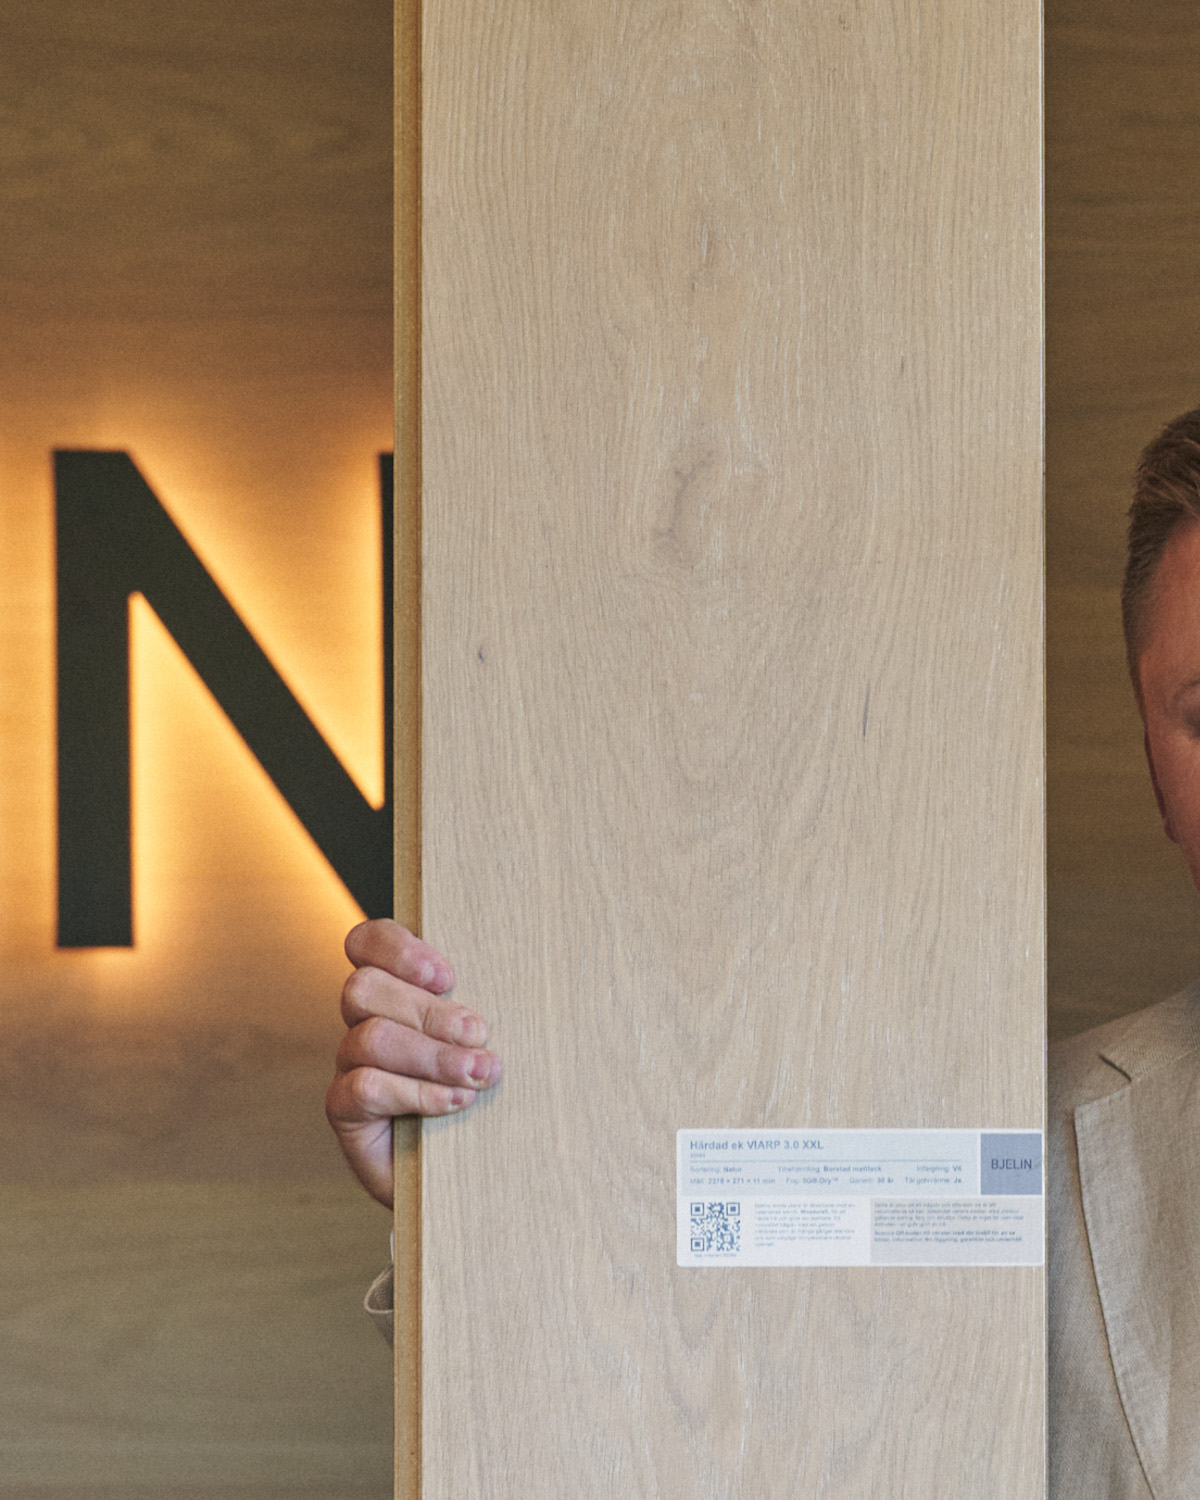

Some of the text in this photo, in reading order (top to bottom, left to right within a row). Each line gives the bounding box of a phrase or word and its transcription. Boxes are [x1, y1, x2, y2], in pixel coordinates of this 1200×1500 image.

[53, 448, 394, 948] N
[690, 1139, 824, 1150] Härdad ek VIARP 3.0 XXL
[991, 1158, 1032, 1170] BJELIN
